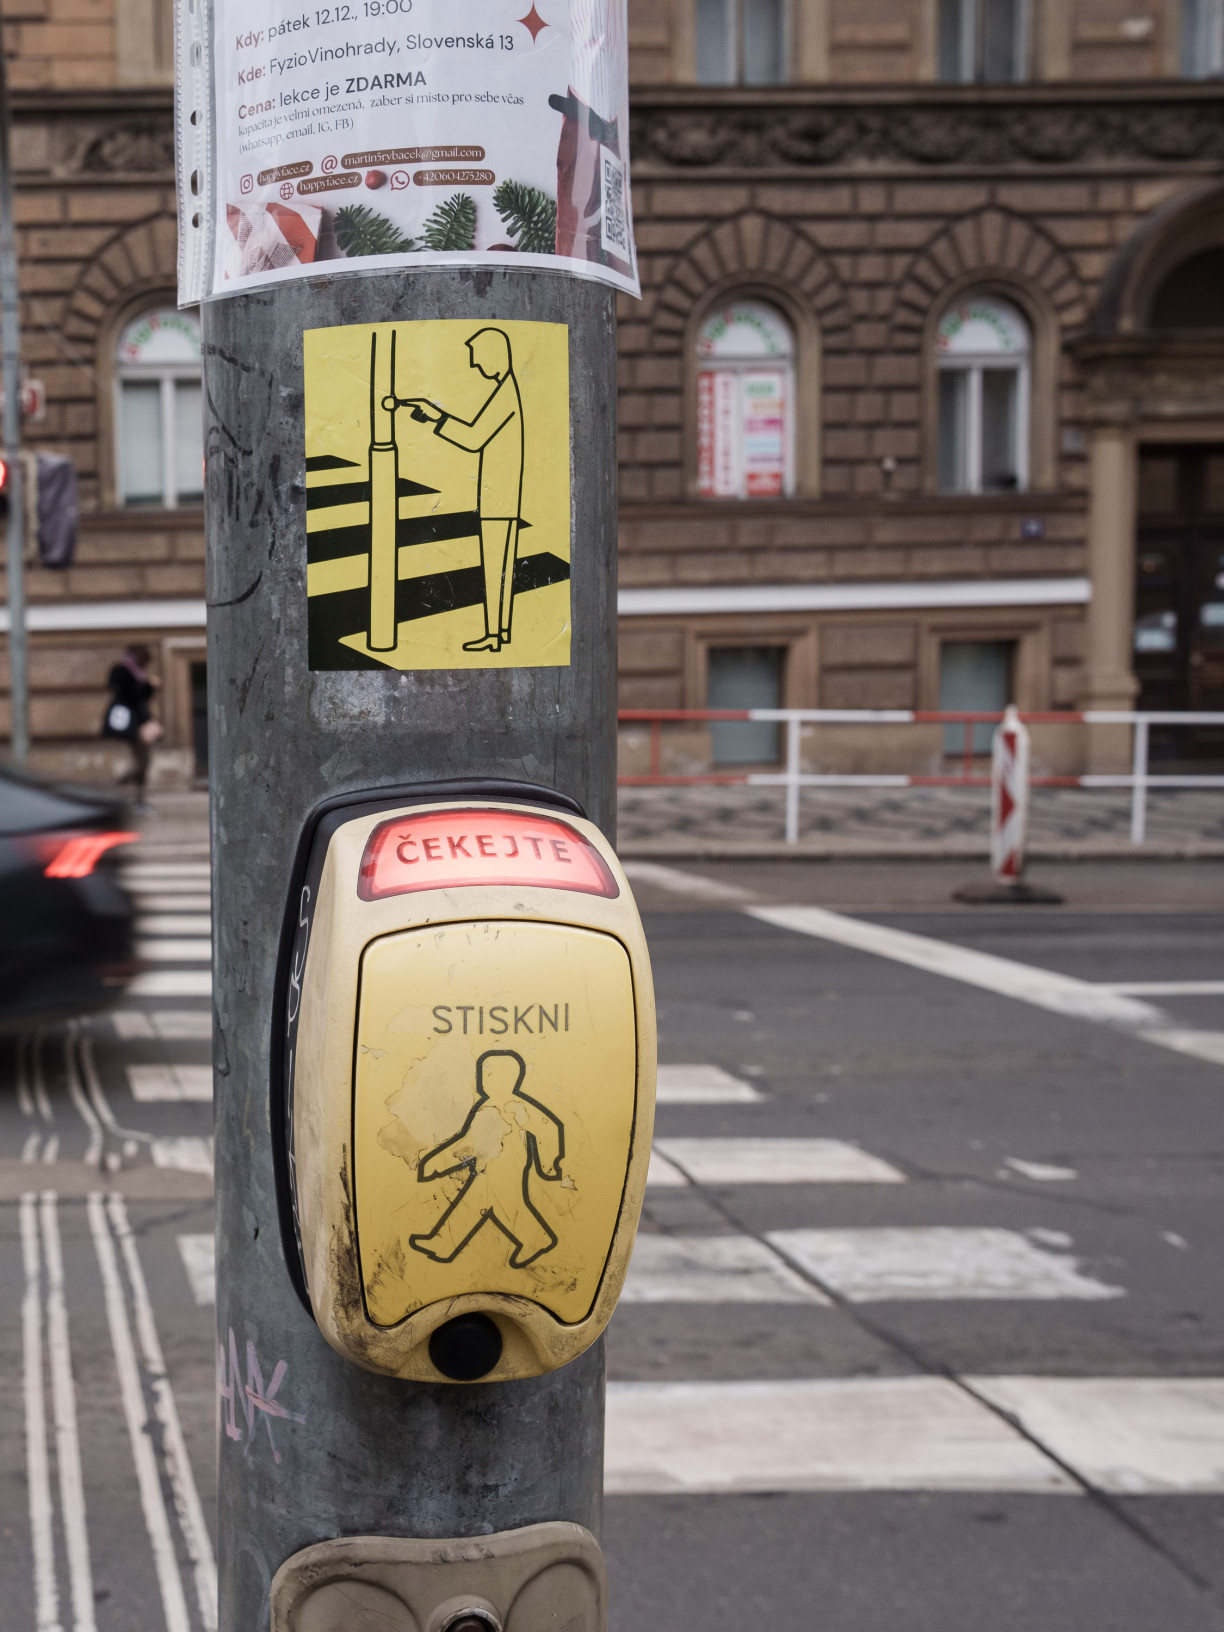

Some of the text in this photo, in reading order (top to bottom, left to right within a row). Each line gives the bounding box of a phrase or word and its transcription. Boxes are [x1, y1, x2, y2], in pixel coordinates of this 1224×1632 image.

[235, 0, 413, 51] Kdy: pátek 12.12., 19:00
[237, 33, 514, 86] Kde: FyzioVinohrady, Slovenská 13
[238, 71, 427, 119] Cena: lekce je ZDARMA
[238, 118, 273, 137] kapacita
[273, 115, 283, 129] je
[284, 107, 310, 124] velmi
[312, 98, 365, 117] omezená,
[370, 95, 403, 108] zaber
[405, 93, 414, 105] si
[452, 93, 472, 106] pro
[474, 91, 500, 104] sebe
[501, 94, 525, 105] včas
[286, 123, 316, 140] email,
[318, 121, 333, 133] IG,
[335, 118, 354, 132] FB)
[259, 163, 310, 184] happyface.cz
[300, 175, 359, 192] happyface.cz
[396, 833, 573, 866] ČEKEJTE
[432, 1003, 570, 1036] STISKNI
